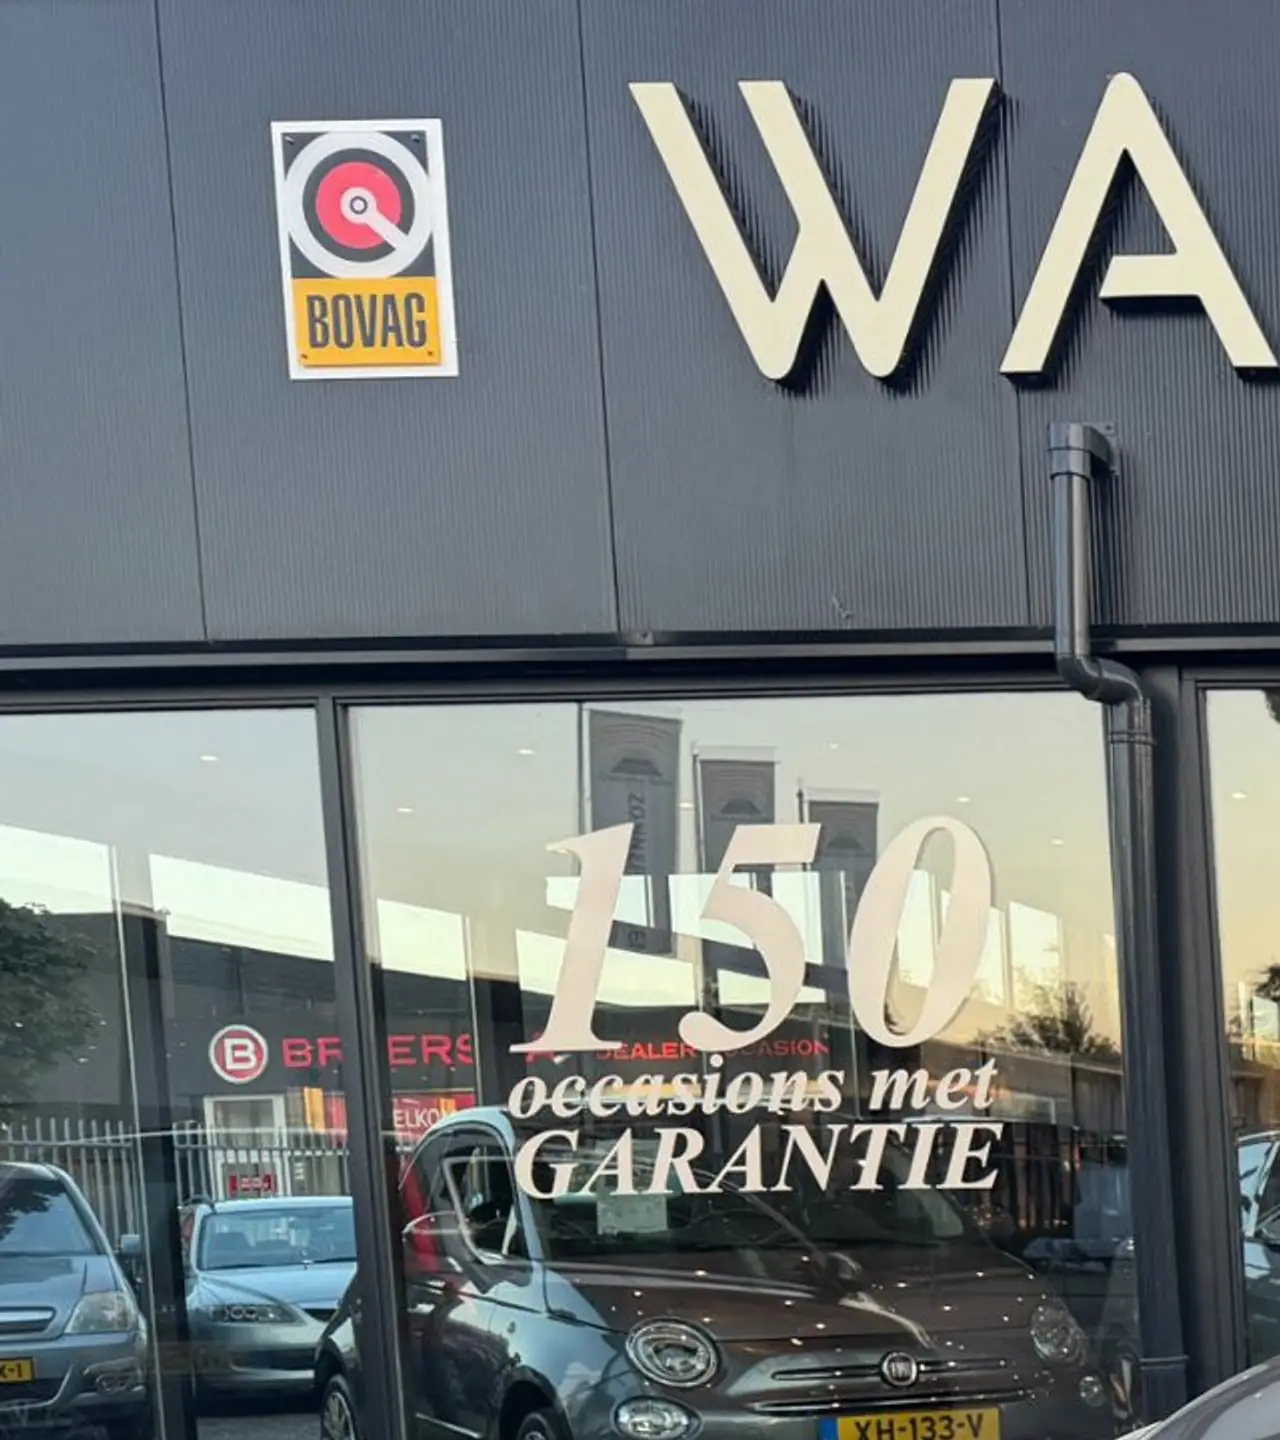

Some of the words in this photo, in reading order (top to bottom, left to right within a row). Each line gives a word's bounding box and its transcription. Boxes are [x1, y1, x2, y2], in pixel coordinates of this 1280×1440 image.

[305, 292, 428, 349] BOVAG
[509, 815, 993, 1053] 150
[507, 1053, 846, 1120] occasions
[867, 1057, 999, 1112] met
[513, 1121, 1004, 1200] GARANTIE
